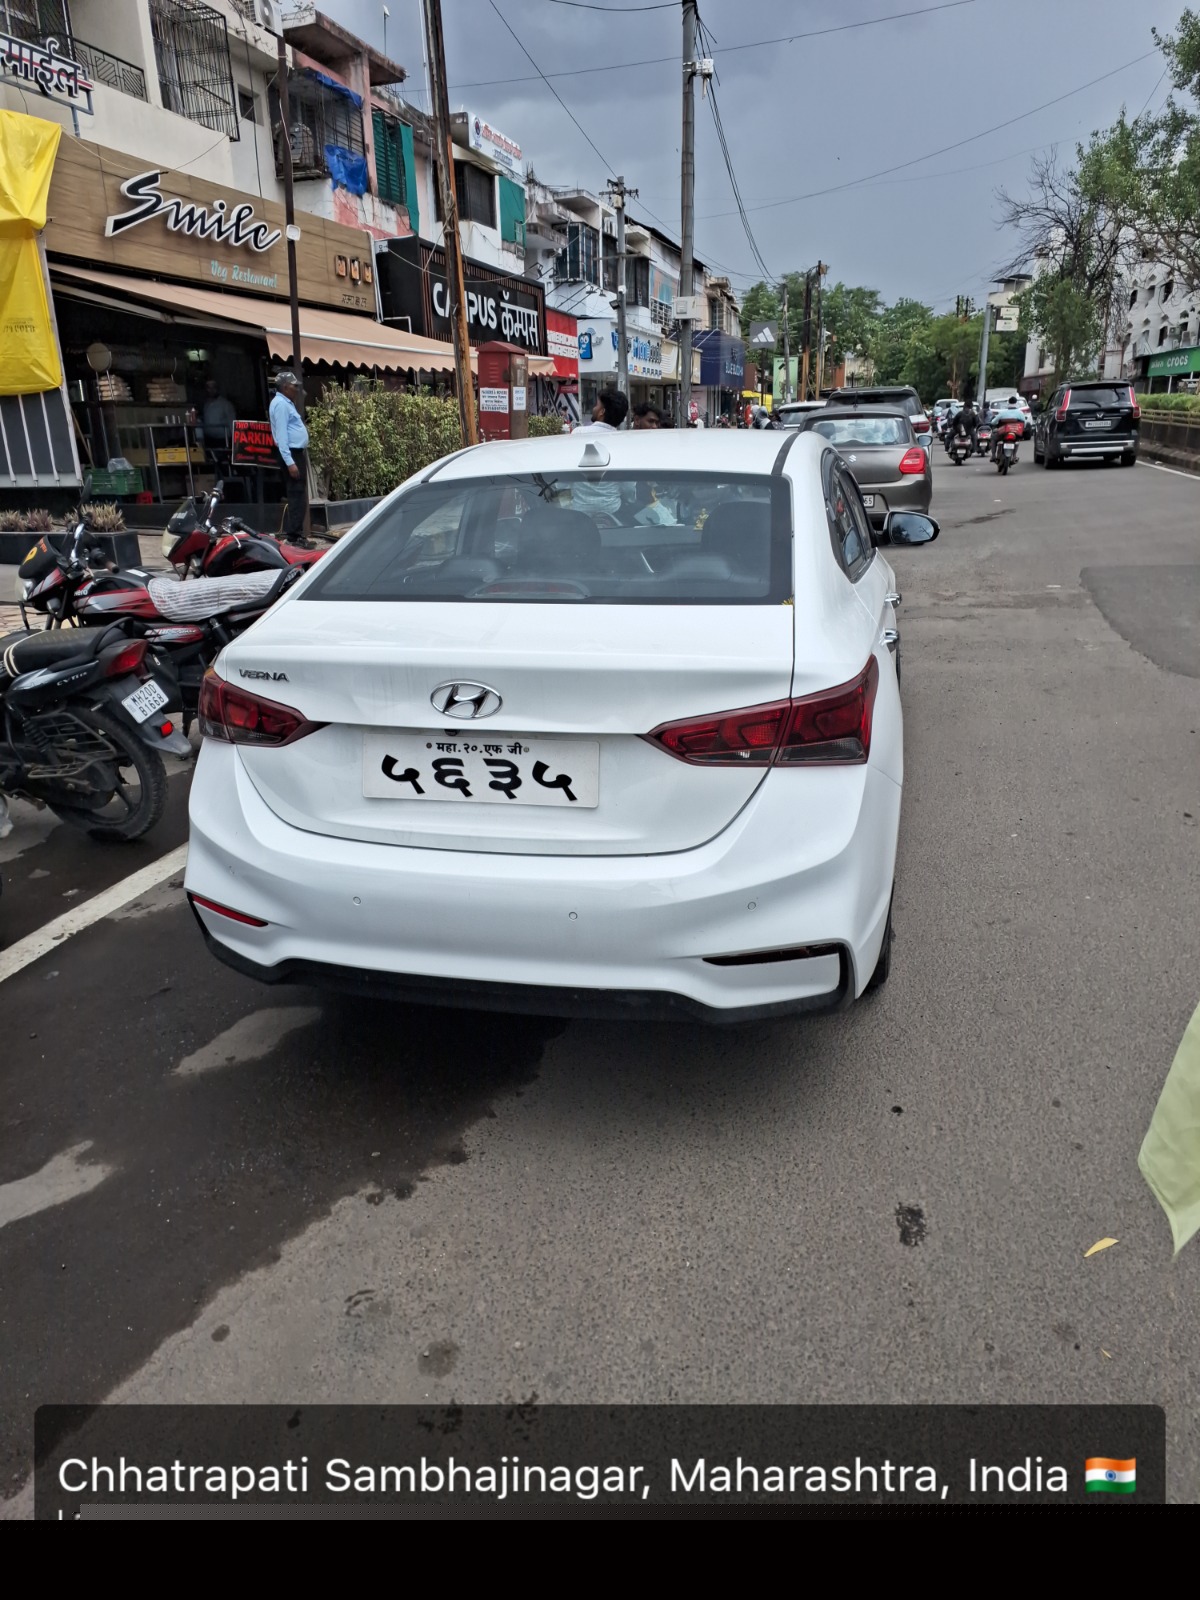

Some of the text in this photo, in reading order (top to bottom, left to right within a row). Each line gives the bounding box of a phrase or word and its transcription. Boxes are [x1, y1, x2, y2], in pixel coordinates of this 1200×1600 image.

[0, 32, 82, 97] माईल
[105, 169, 282, 253] Smile
[210, 260, 278, 288] Veg Restaurant
[432, 282, 498, 330] CPUS
[1166, 355, 1189, 368] crocs
[235, 422, 271, 431] TWO WHEE
[234, 431, 273, 447] PARKIN
[239, 668, 290, 682] VERNA
[131, 683, 157, 706] MH20D
[139, 693, 165, 716] B1668
[507, 742, 523, 755] जी
[381, 754, 578, 801] ५६३५
